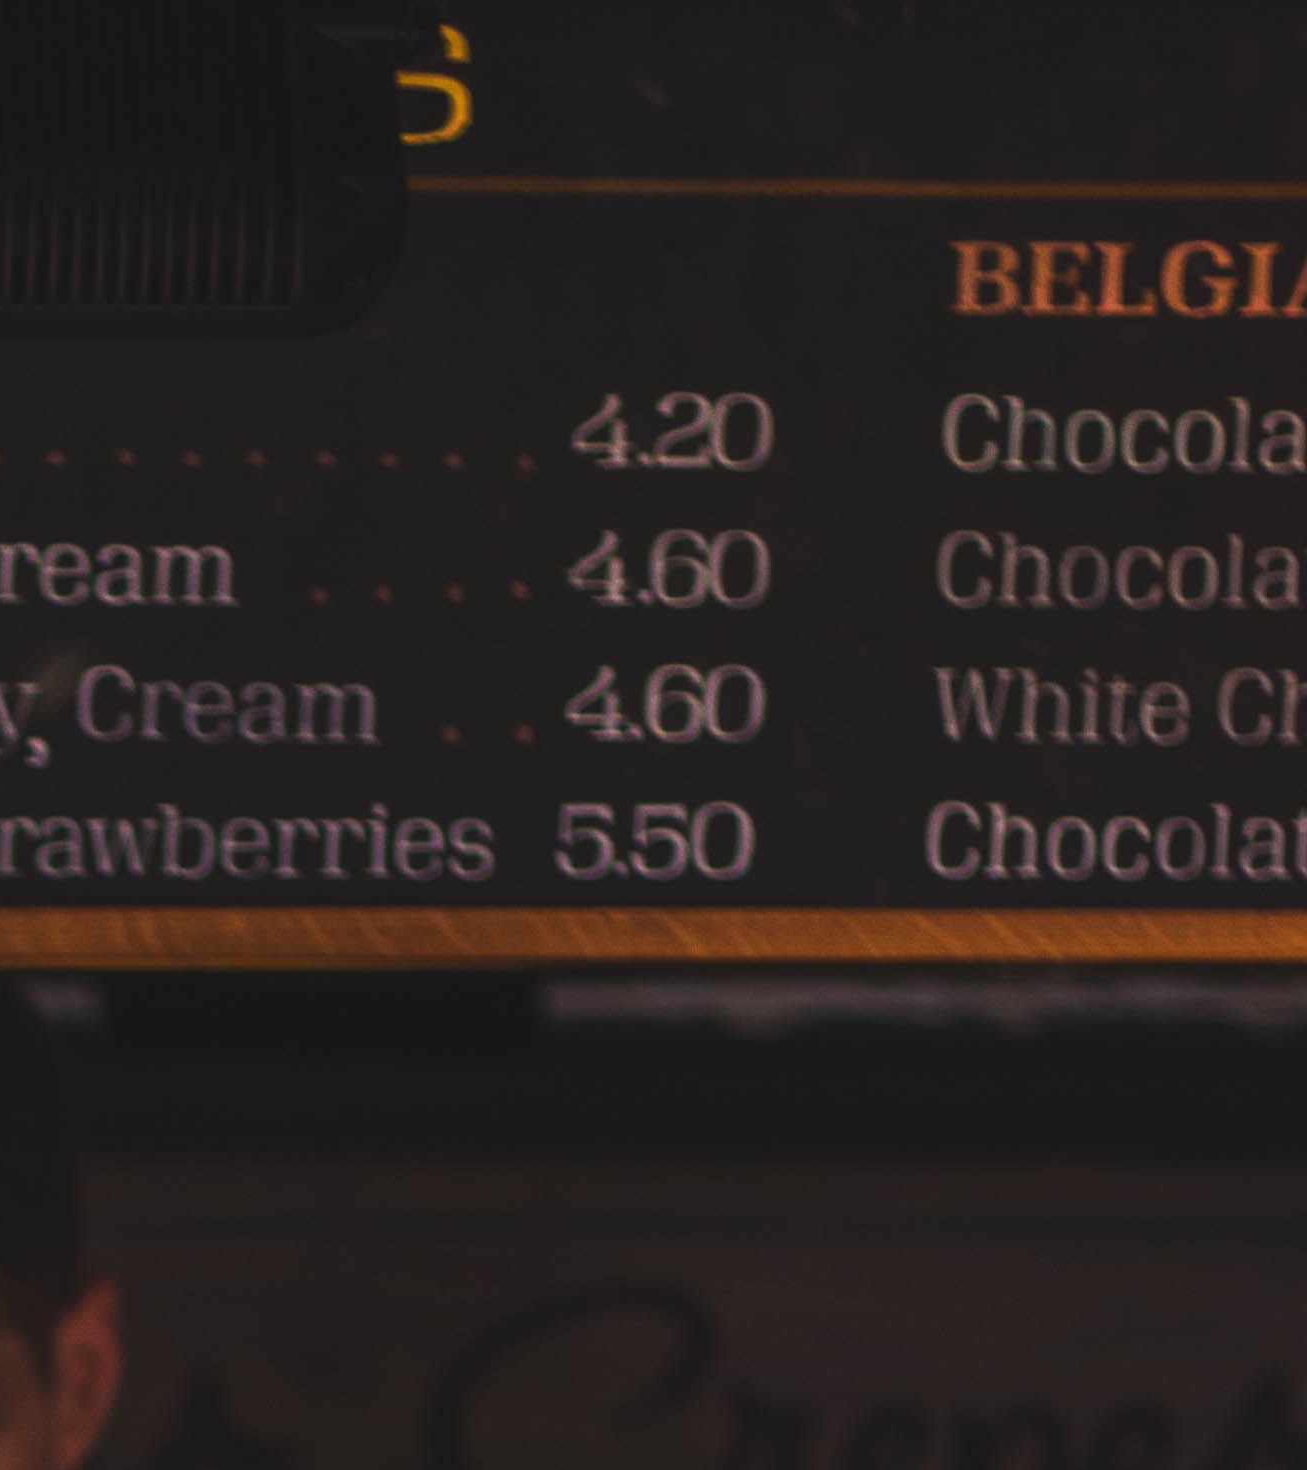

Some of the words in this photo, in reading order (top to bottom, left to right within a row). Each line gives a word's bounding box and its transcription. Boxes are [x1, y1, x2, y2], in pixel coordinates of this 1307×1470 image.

[571, 391, 775, 471] 4.20
[568, 528, 771, 608] 4.60
[75, 662, 379, 745] Cream
[564, 662, 767, 743] 4.60
[934, 666, 1191, 746] White
[555, 800, 756, 879] 5.50
